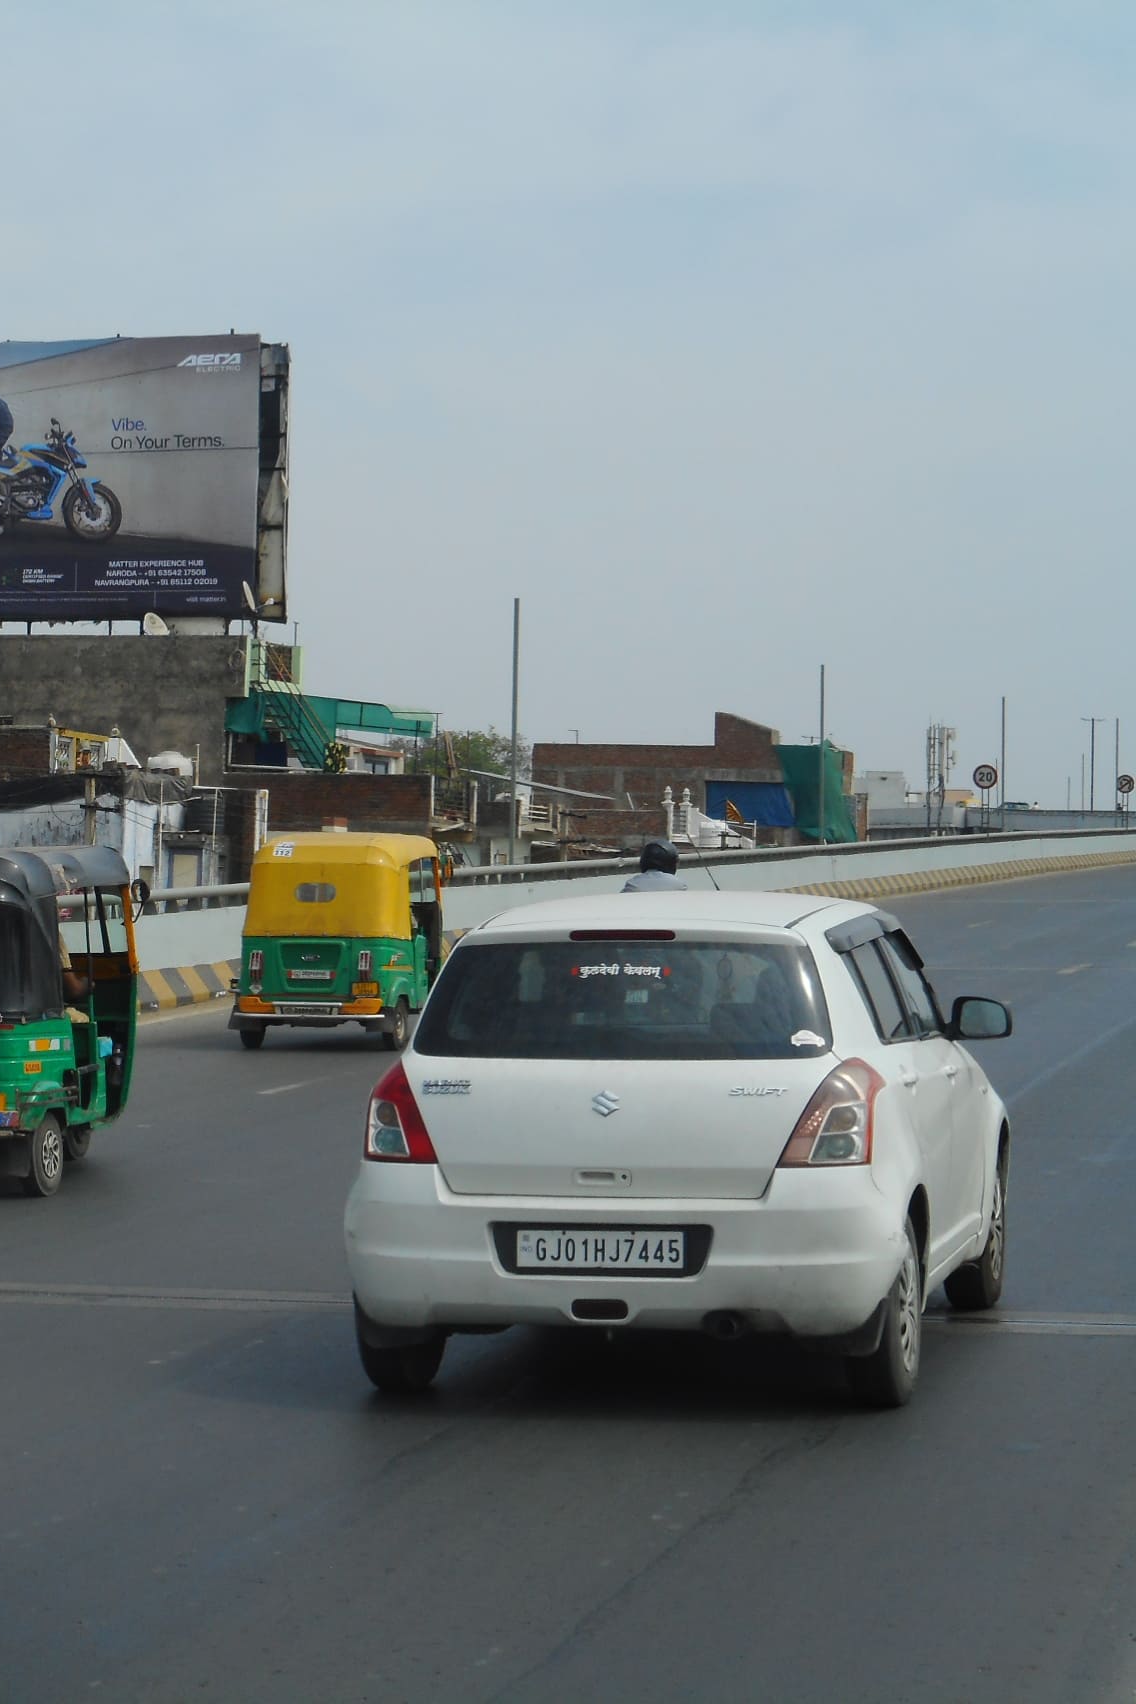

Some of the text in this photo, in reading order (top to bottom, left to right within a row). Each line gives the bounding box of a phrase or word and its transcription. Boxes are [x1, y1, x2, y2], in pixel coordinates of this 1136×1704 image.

[196, 365, 241, 373] ELECTRIC
[112, 417, 147, 432] Vibe.
[111, 434, 225, 450] On Your Terms.
[978, 772, 993, 782] 20
[579, 963, 620, 979] कुलदेवी
[423, 1086, 472, 1094] SUZUKI
[728, 1087, 789, 1097] SWIFT
[536, 1238, 680, 1263] GJ01HJ7445
